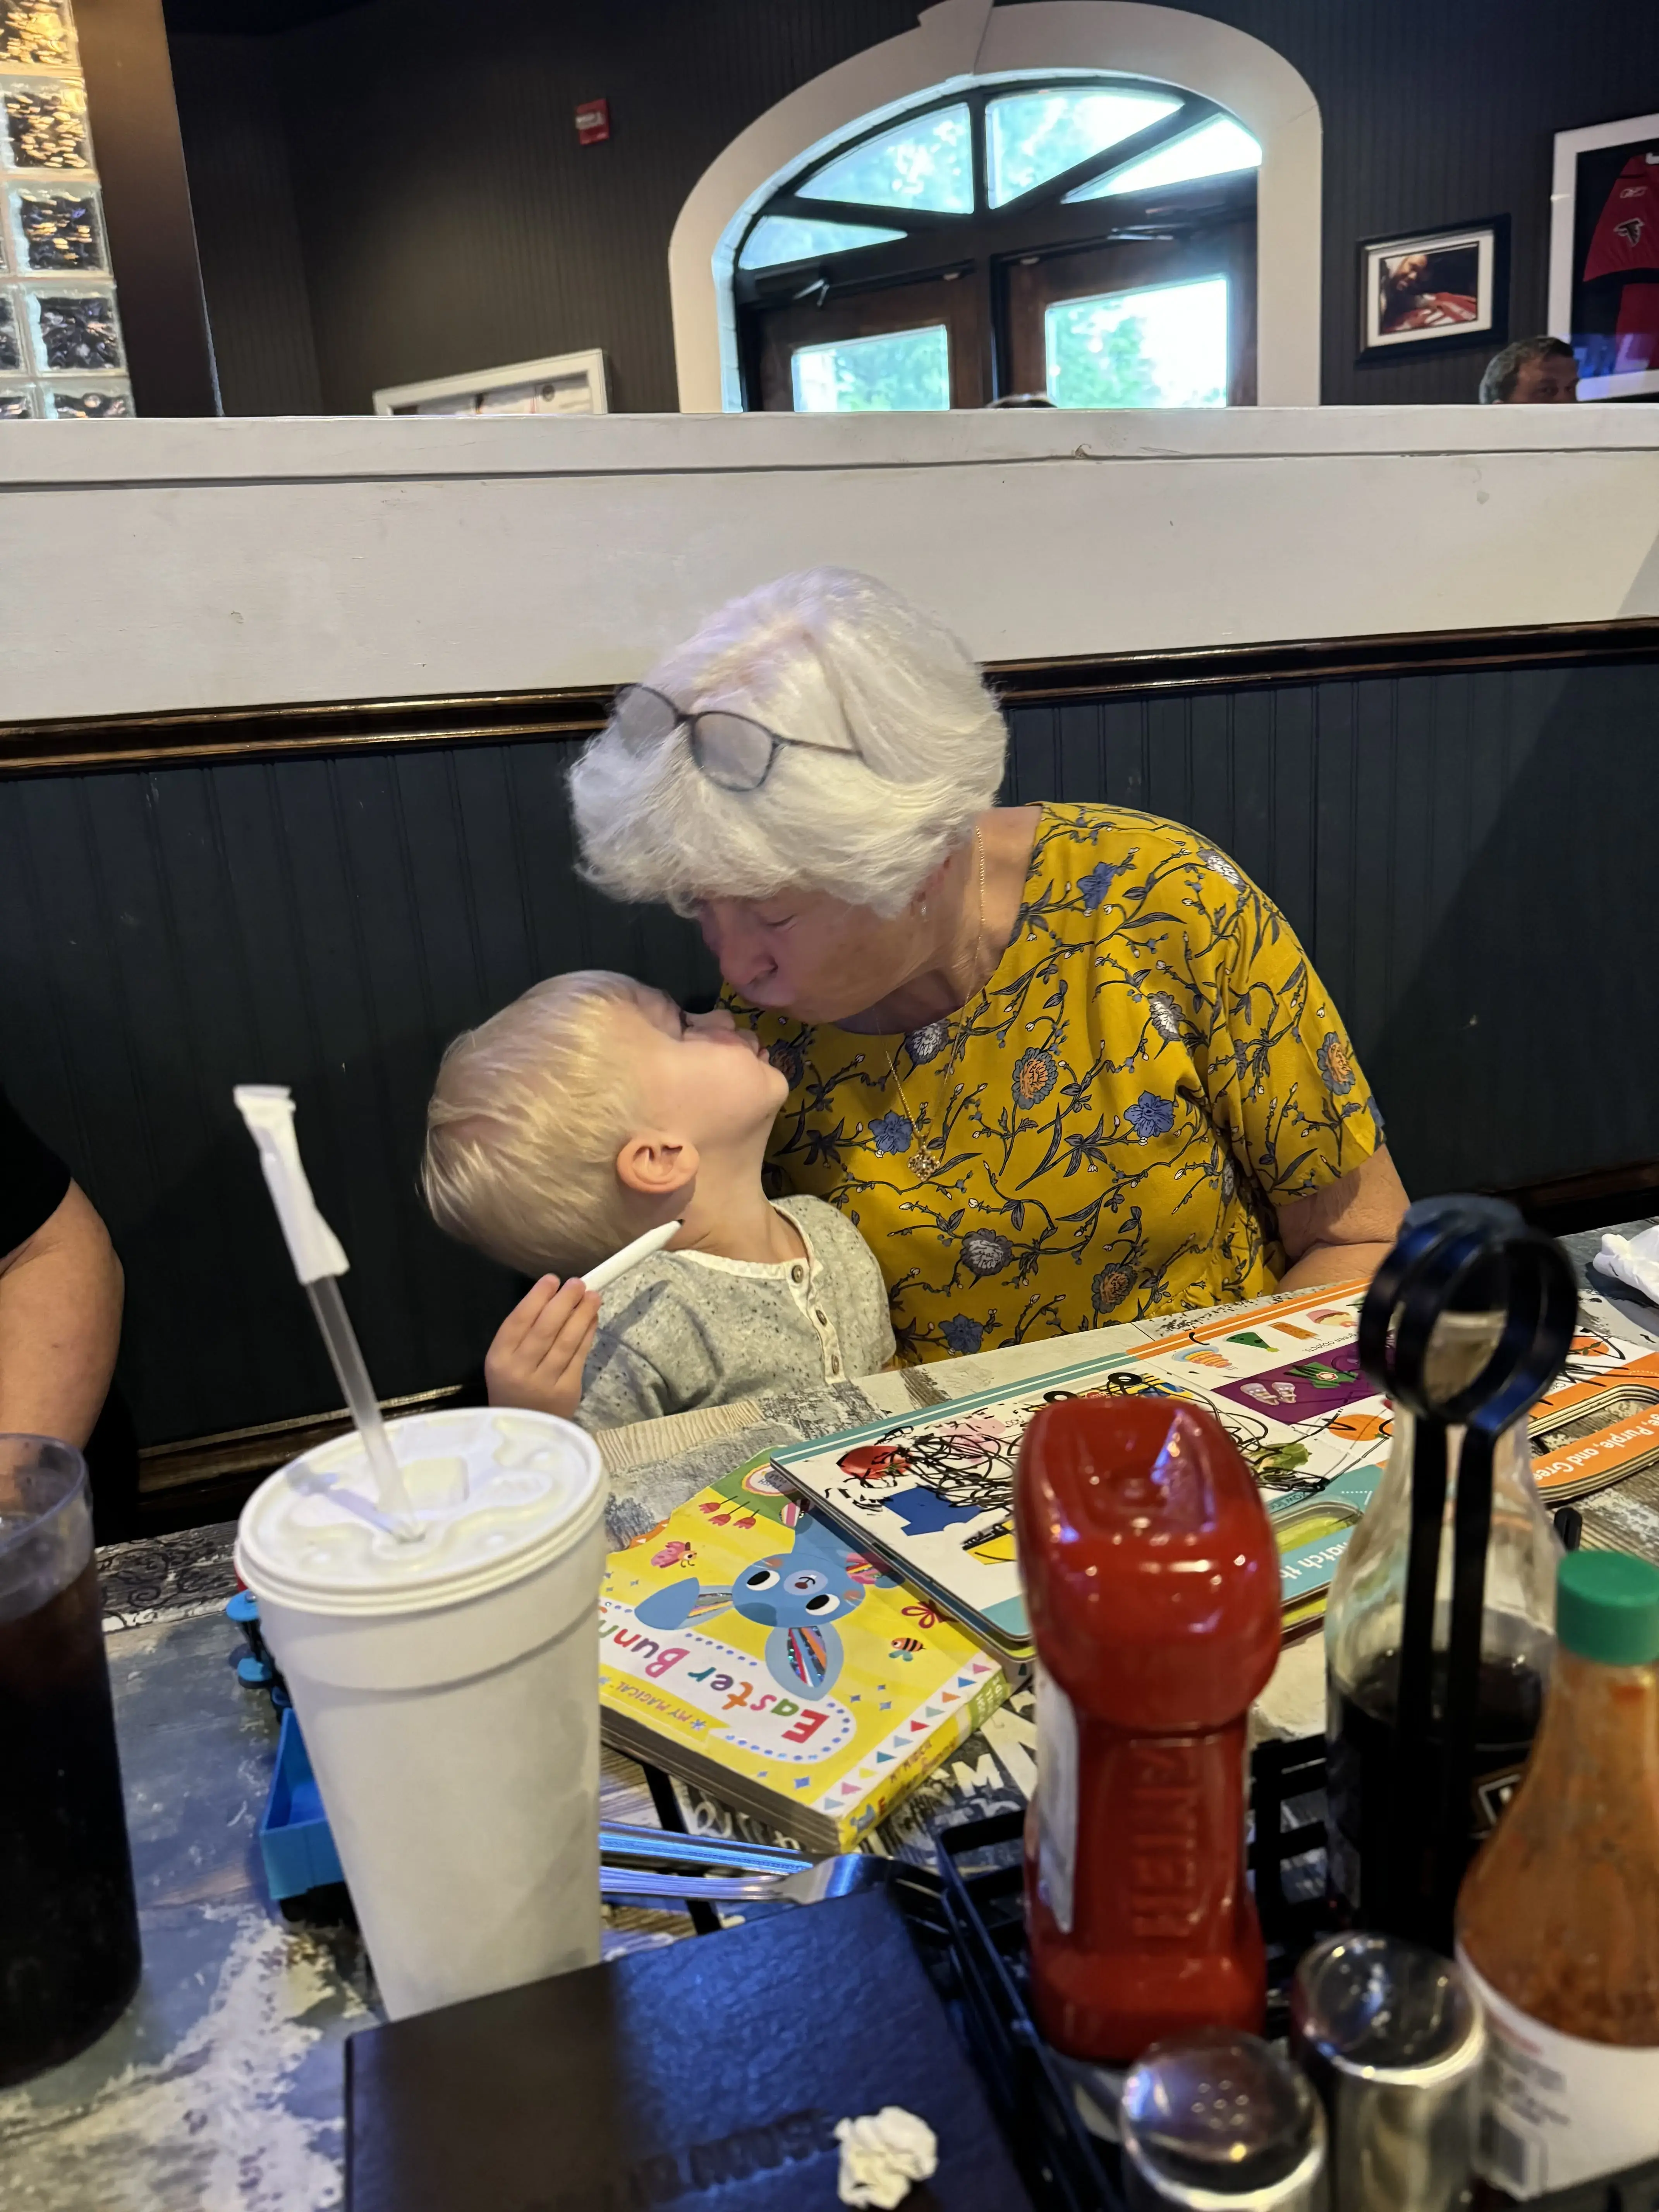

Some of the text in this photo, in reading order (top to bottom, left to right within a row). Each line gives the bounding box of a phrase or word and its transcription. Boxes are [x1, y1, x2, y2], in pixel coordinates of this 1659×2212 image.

[1334, 1333, 1357, 1342] green
[1533, 1425, 1655, 1481] Purple, and Gree
[758, 1479, 782, 1489] PUSH
[1279, 1565, 1302, 1580] th
[598, 1606, 830, 1744] Easter Bunn
[619, 1681, 693, 1723] MY MAGICAL
